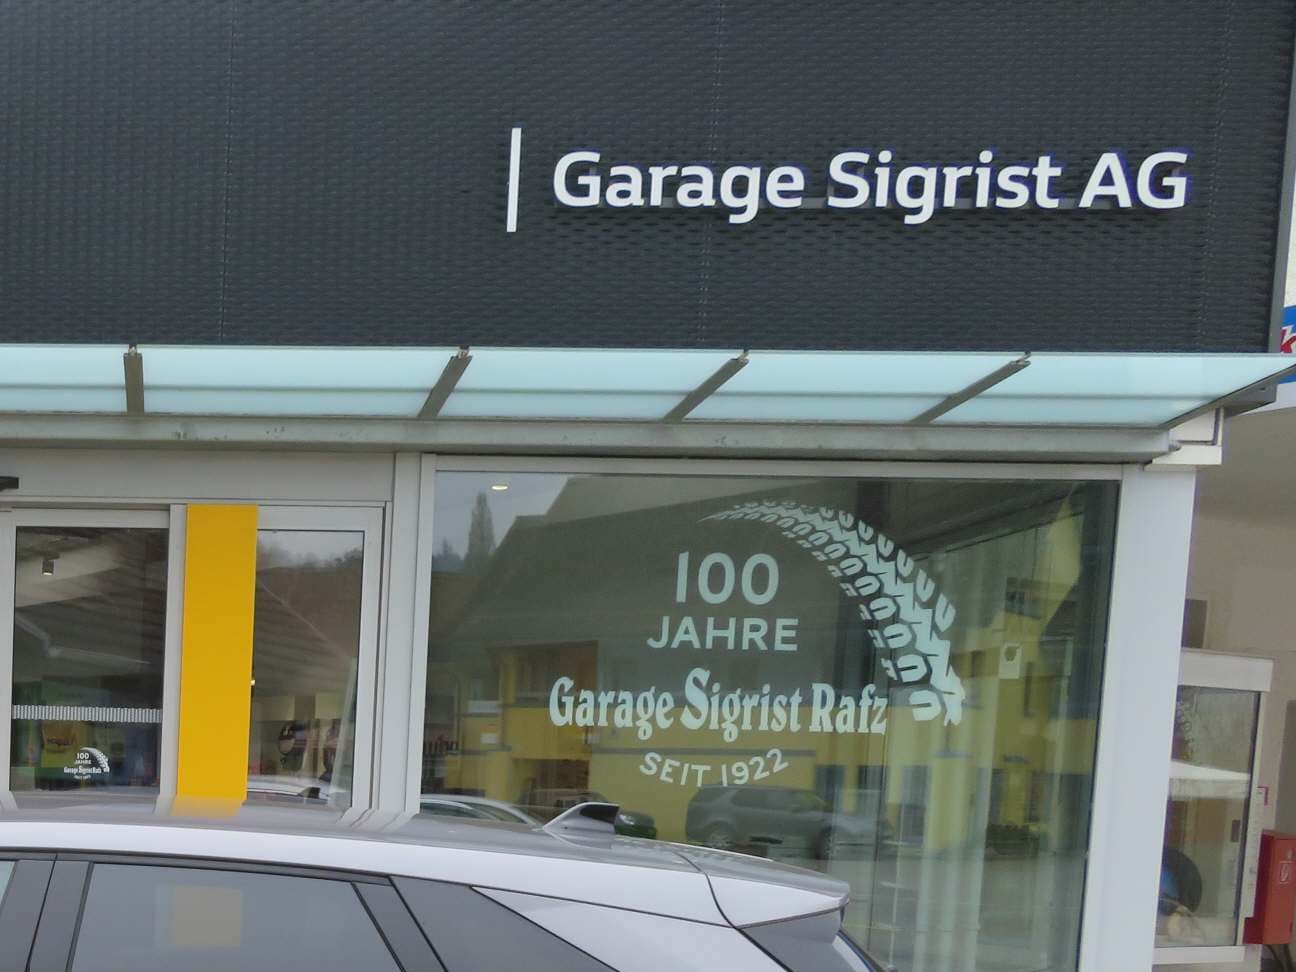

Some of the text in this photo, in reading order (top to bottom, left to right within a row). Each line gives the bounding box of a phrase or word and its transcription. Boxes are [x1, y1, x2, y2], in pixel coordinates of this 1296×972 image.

[553, 150, 1188, 225] Garage Sigrist AG
[676, 551, 780, 605] 100
[647, 615, 799, 651] JAHRE
[549, 667, 889, 743] Garage Sigrist Rafz
[639, 748, 789, 788] SEIT 1922
